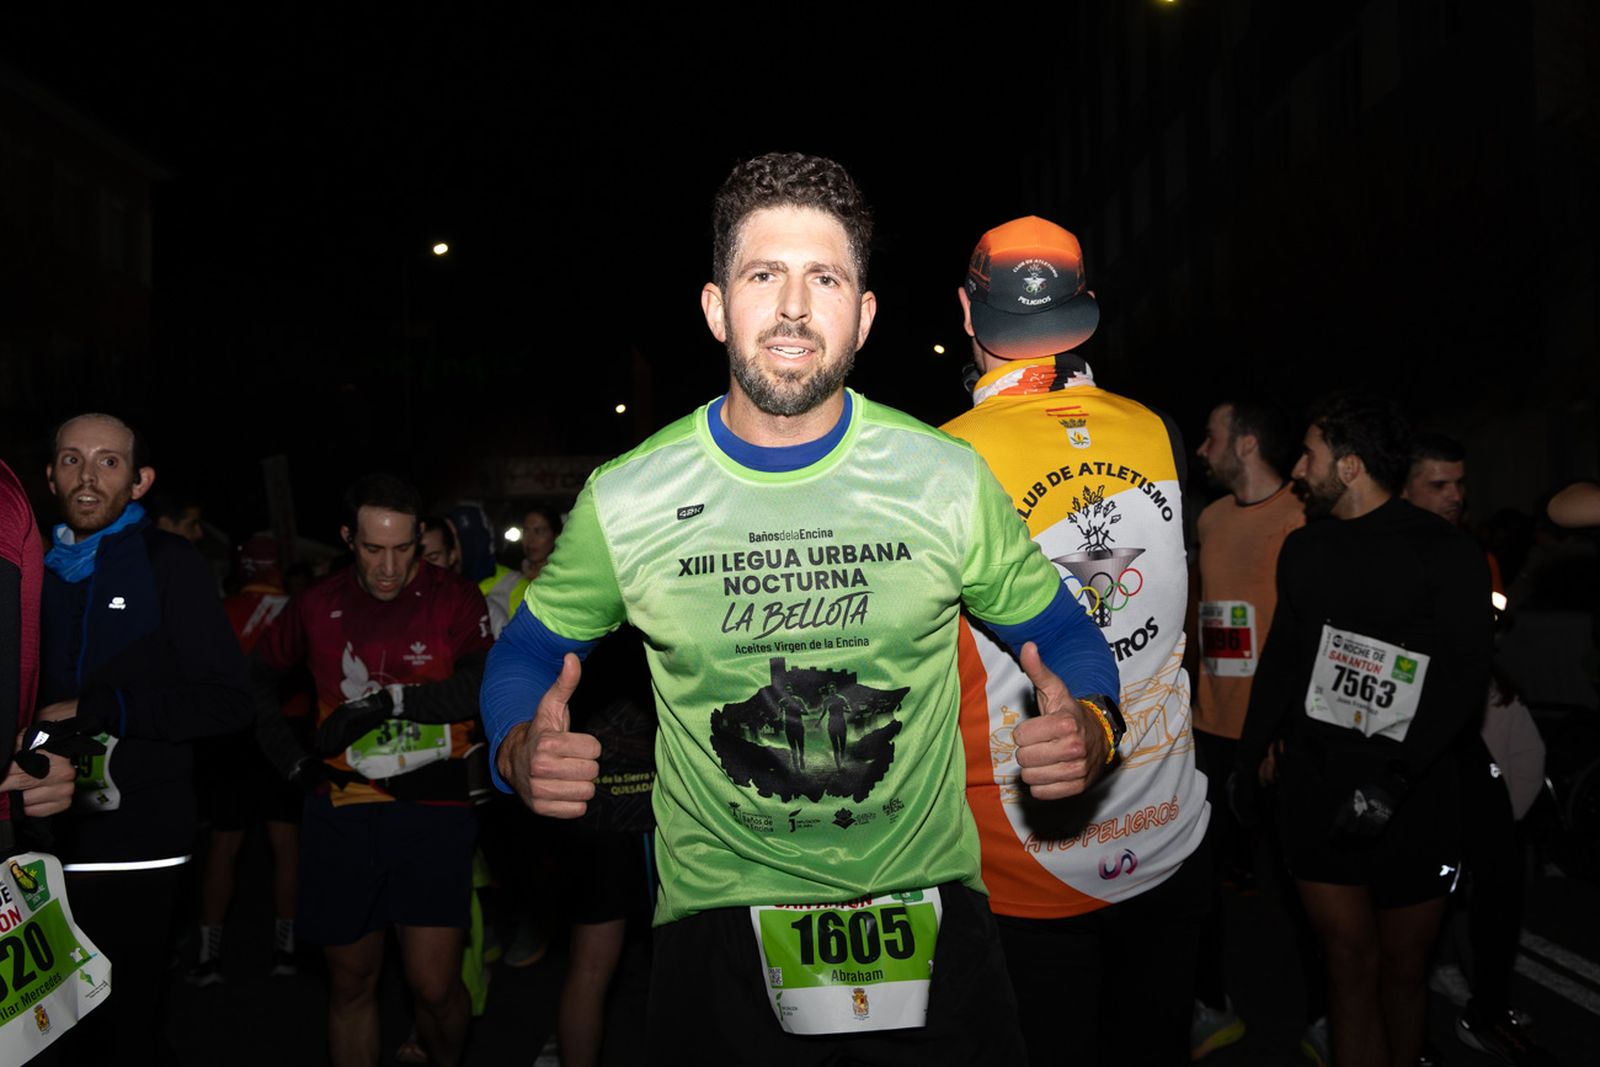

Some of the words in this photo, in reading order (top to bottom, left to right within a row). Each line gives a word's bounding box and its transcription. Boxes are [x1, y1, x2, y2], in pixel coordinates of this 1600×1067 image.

[1018, 296, 1052, 305] PELIGROS
[1017, 481, 1048, 523] LUB
[1046, 466, 1074, 487] DE
[1078, 462, 1173, 522] ATLETISMO
[678, 554, 715, 577] XIII
[721, 549, 801, 572] LEGUA
[807, 541, 912, 566] URBANA
[723, 567, 869, 597] NOCTURNA
[721, 601, 755, 633] LA
[752, 590, 874, 640] BELLOTA
[735, 643, 772, 655] Aceites
[773, 639, 807, 653] Virgen
[809, 639, 822, 649] de
[824, 637, 834, 649] la
[836, 636, 870, 648] Encina
[1373, 650, 1387, 664] DE
[1332, 665, 1397, 709] 7563
[791, 907, 916, 965] 1605
[20, 972, 62, 1007] Mercedes
[831, 969, 884, 983] Abraham
